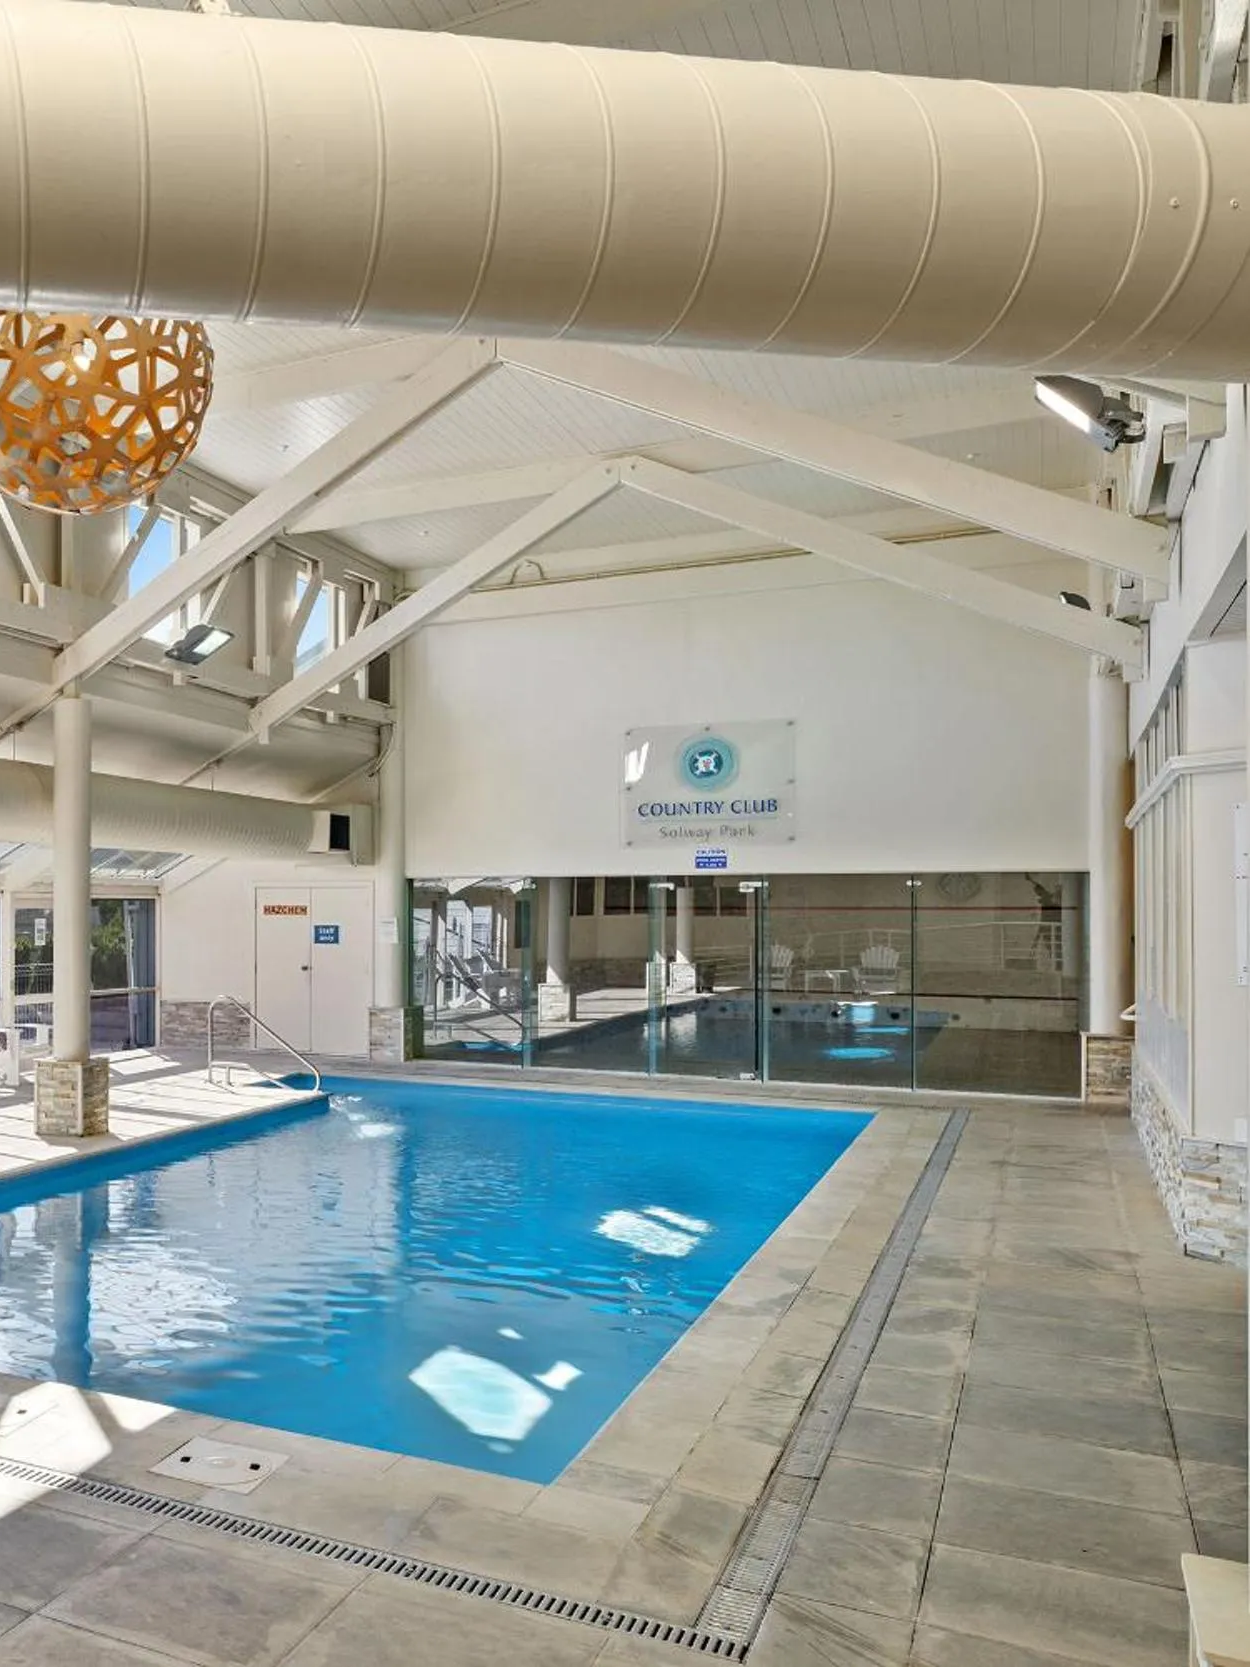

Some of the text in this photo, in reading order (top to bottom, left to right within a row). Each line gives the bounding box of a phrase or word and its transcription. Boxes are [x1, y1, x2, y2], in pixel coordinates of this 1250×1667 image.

[638, 799, 778, 817] COUNTRY CLUB
[659, 825, 757, 841] Solway Park
[263, 905, 307, 915] HAZCHEM
